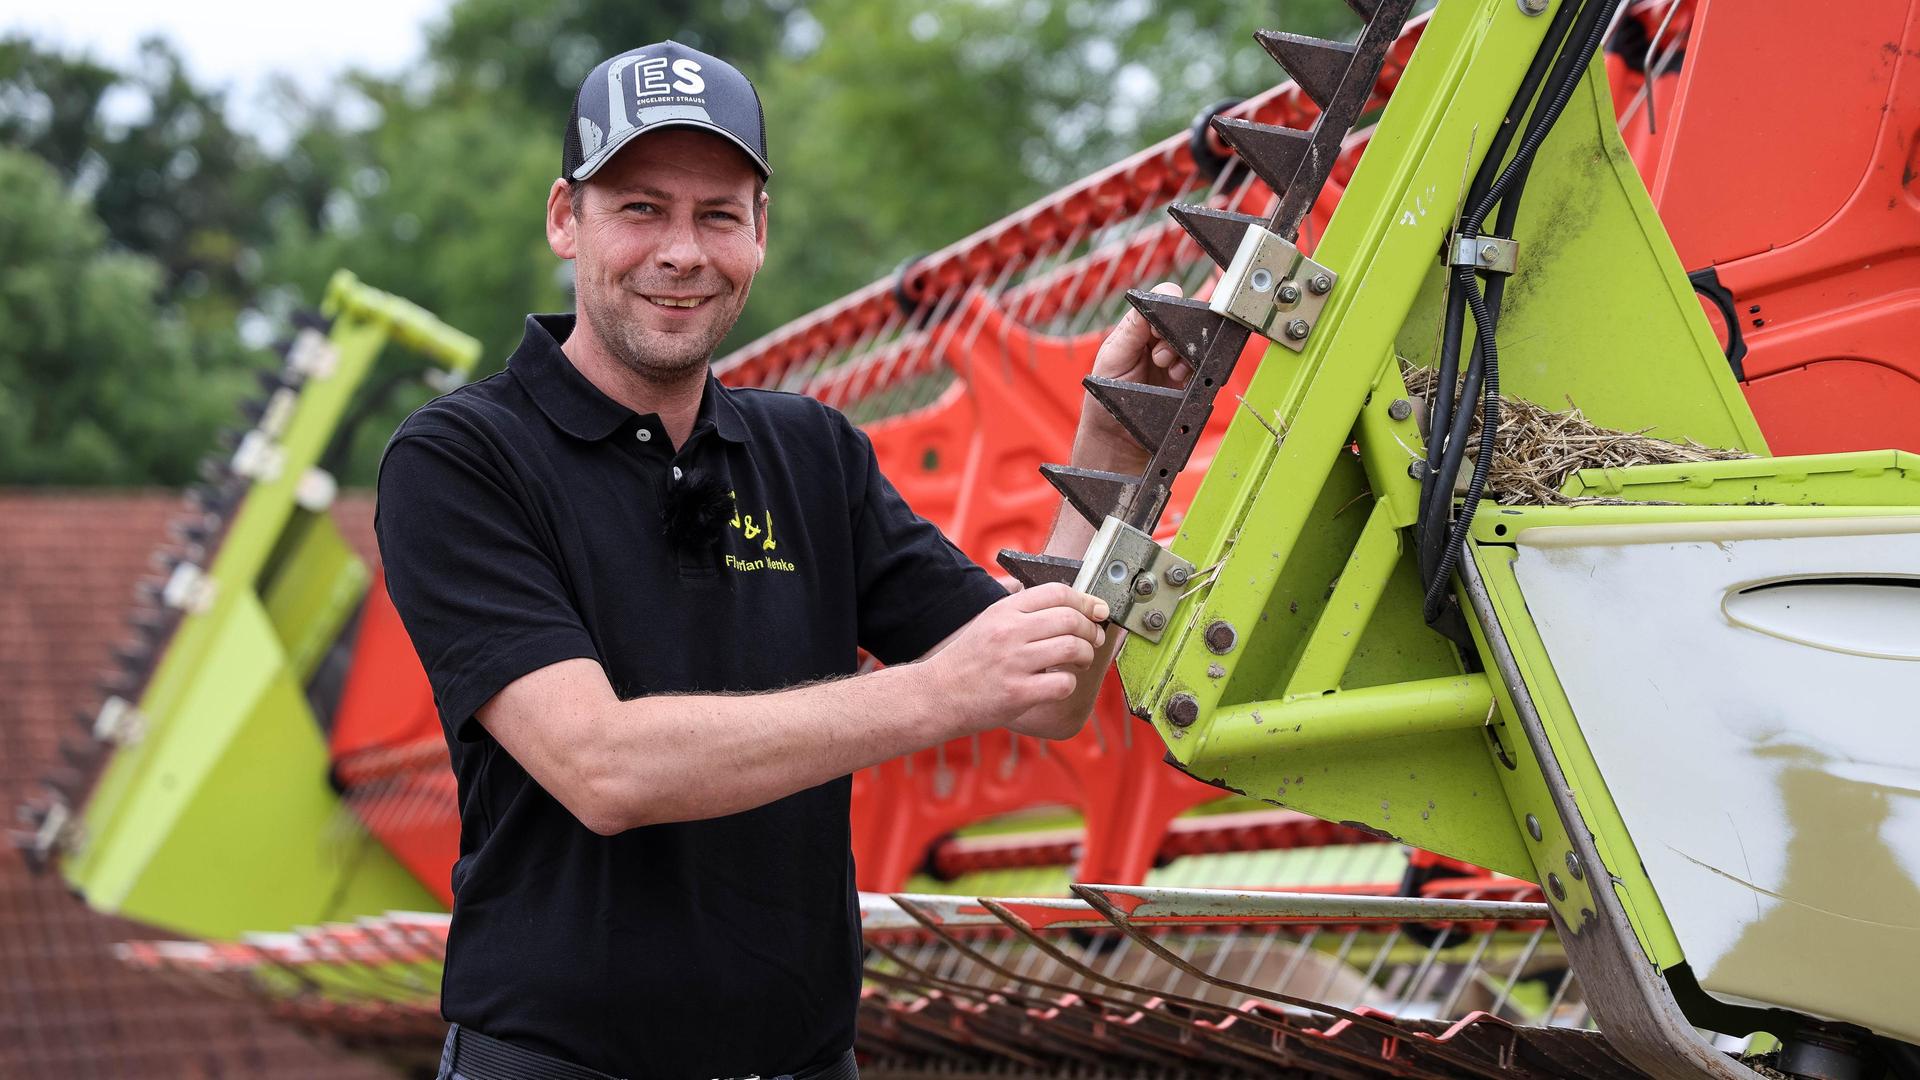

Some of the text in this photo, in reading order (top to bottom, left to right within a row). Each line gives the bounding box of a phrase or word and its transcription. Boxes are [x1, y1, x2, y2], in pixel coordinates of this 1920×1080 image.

[634, 57, 706, 97] ES
[637, 96, 706, 106] ENGELBERT STRAUSS
[744, 514, 762, 540] &
[725, 554, 765, 572] Flrian
